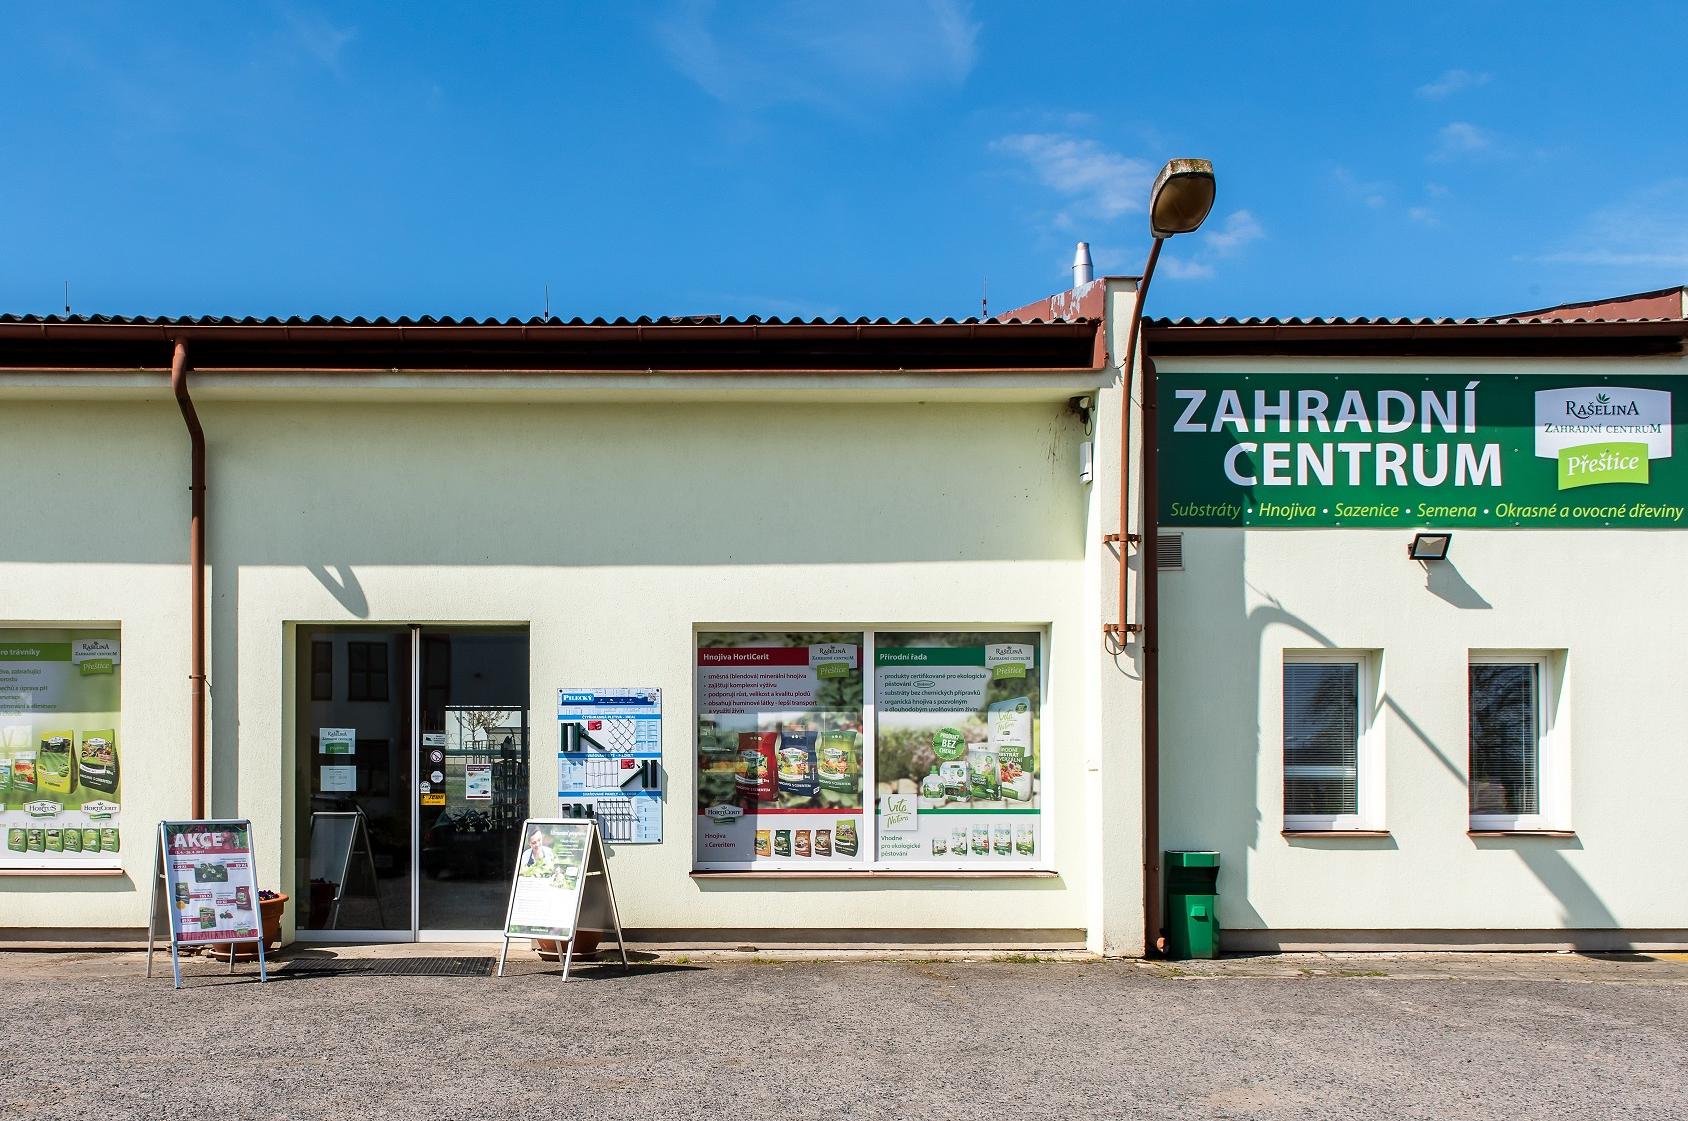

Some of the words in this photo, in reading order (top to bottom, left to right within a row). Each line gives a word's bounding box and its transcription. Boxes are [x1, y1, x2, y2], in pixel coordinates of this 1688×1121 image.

[1173, 380, 1480, 433] ZAHRADNÍ
[1544, 422, 1602, 434] ZAHRADNÍ
[1605, 423, 1662, 434] CENTRUM
[1223, 442, 1503, 487] CENTRUM
[1567, 452, 1640, 476] Přeštice
[1170, 502, 1241, 520] Substráty
[1258, 502, 1317, 520] Hnojiva
[1334, 502, 1400, 518] Sazenice
[1417, 503, 1477, 518] Semena
[1495, 502, 1557, 518] Okrasné
[1559, 506, 1569, 518] a
[1572, 502, 1626, 518] ovocné
[1629, 503, 1684, 521] dřeviny
[703, 653, 732, 661] Hnojiva
[941, 739, 957, 748] BEZ
[174, 832, 223, 848] AKCE
